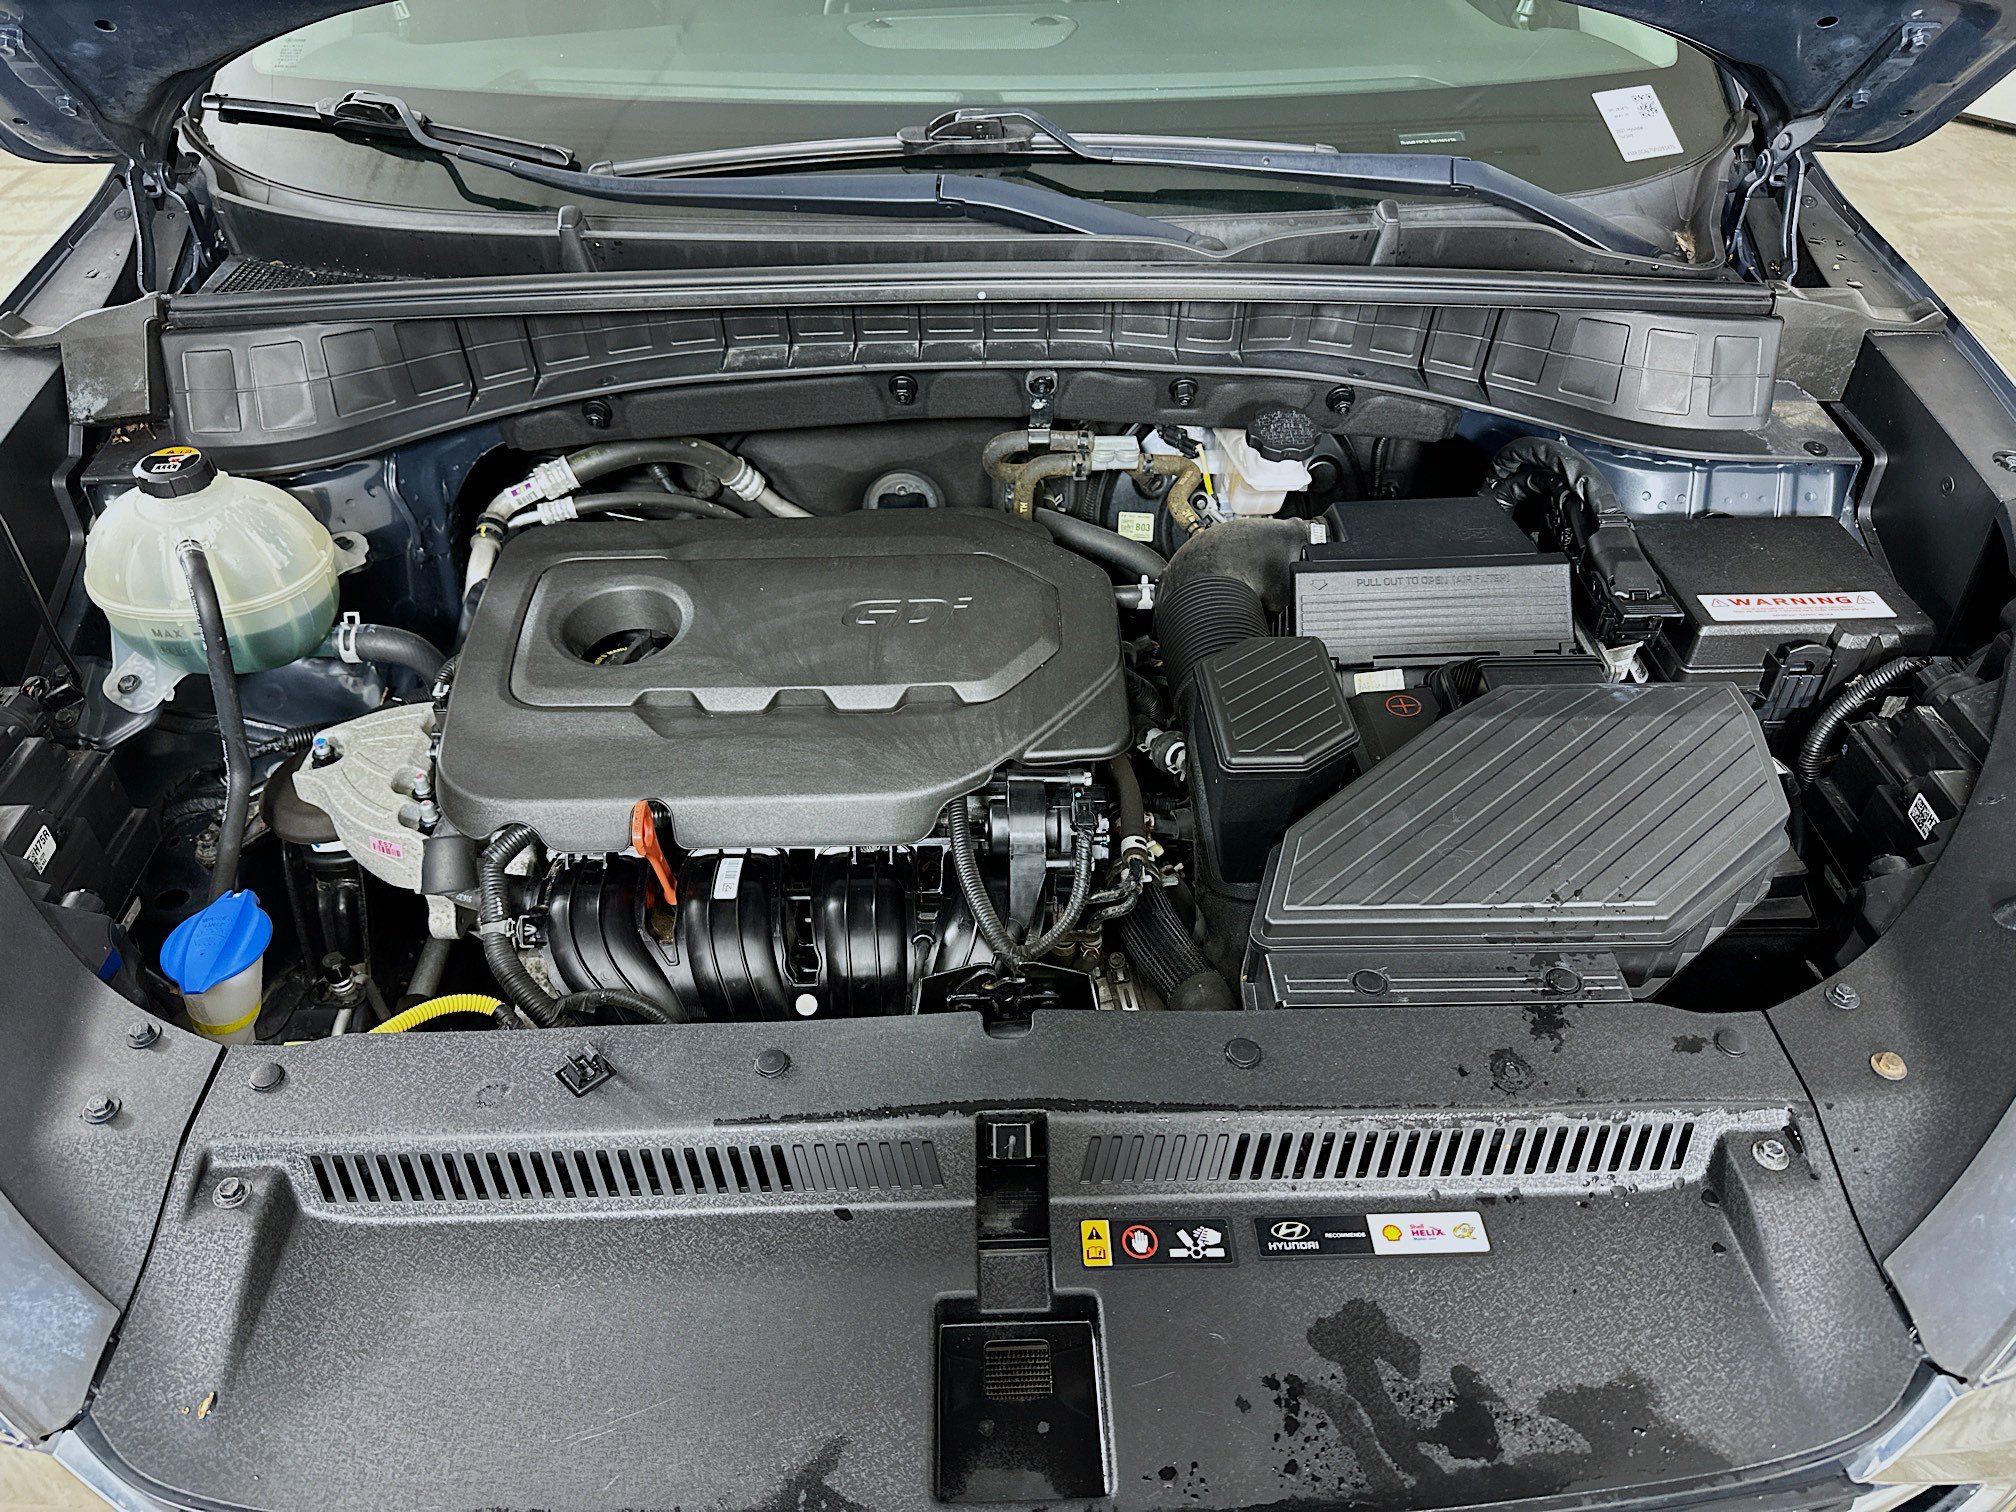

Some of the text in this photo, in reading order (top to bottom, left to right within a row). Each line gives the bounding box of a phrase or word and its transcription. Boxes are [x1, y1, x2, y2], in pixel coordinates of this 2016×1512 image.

[1356, 577, 1382, 587] PULL
[1383, 576, 1404, 586] OUT
[1405, 576, 1419, 585] TO
[1421, 575, 1448, 585] OPEN
[1728, 596, 1852, 606] WARNING
[151, 628, 183, 639] MAX
[1324, 1231, 1367, 1239] RECOMMENDS
[1411, 1227, 1446, 1237] HELIX
[1268, 1240, 1320, 1251] HYUNDAI
